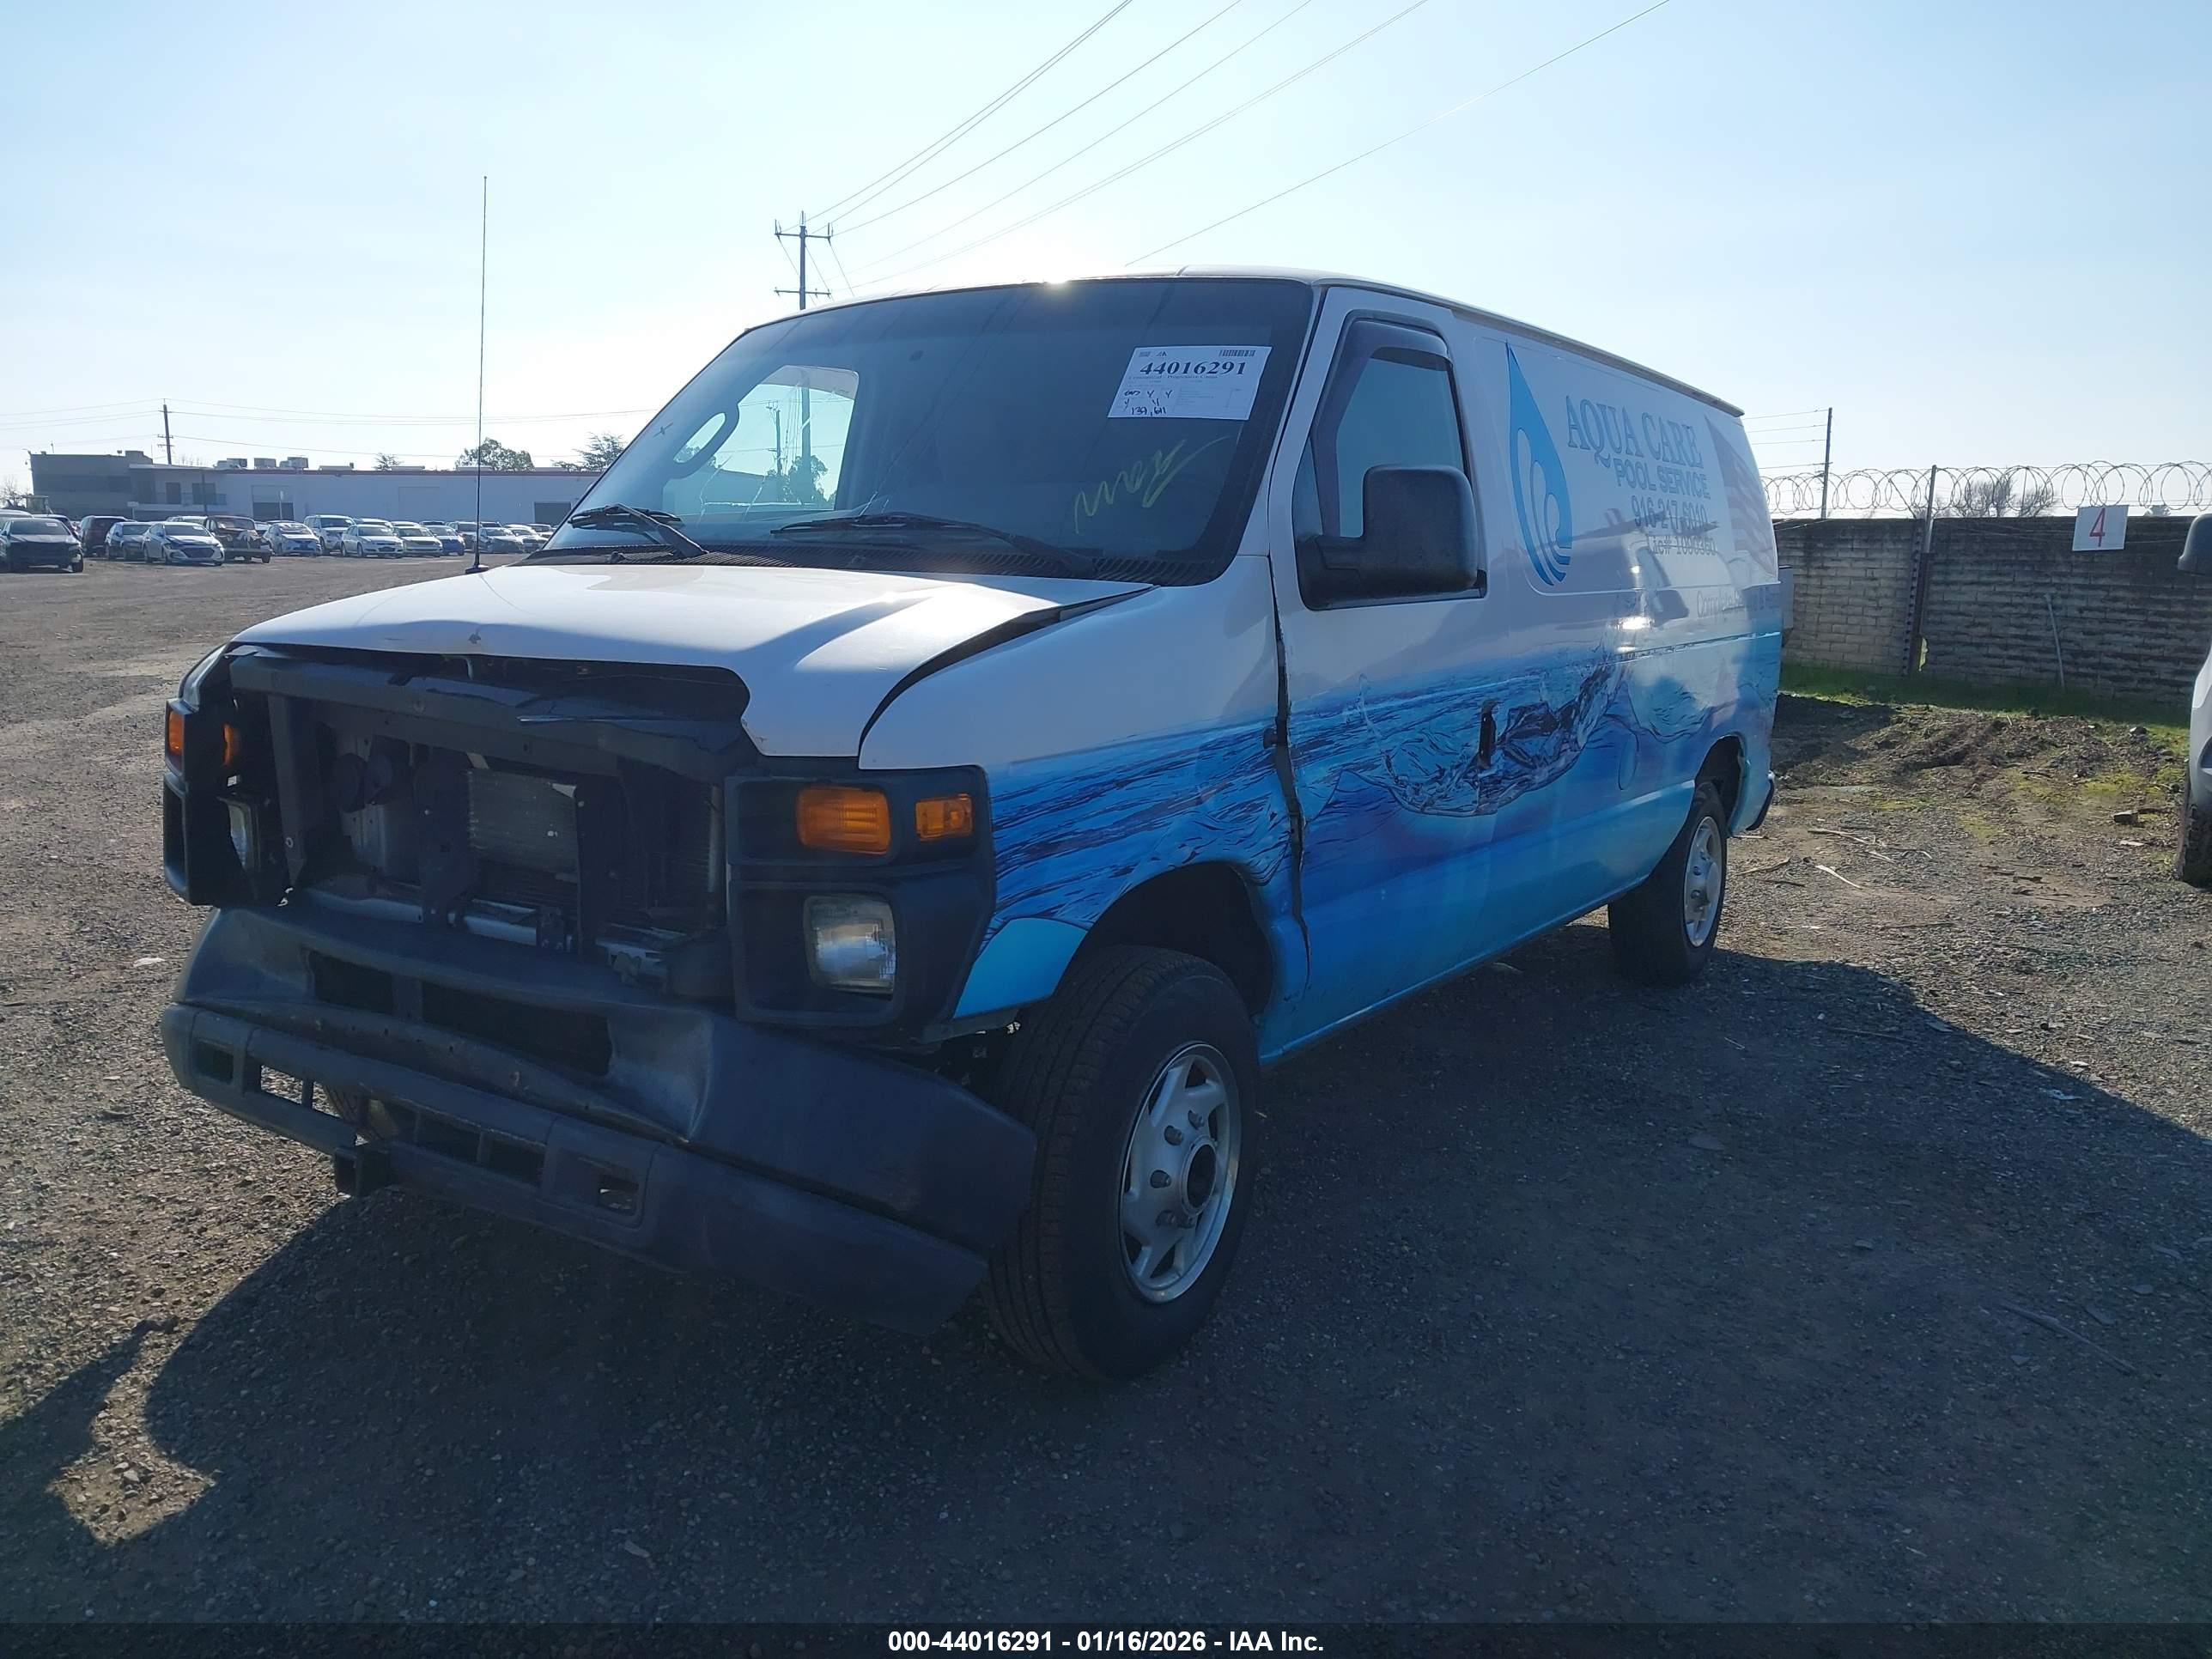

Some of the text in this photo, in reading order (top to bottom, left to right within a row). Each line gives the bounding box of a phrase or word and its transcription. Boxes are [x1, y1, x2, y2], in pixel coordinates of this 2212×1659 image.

[1139, 361, 1245, 376] 44016291
[1565, 395, 1704, 469] AQUA CARE
[1614, 459, 1711, 499] POOL SERVICE
[2088, 507, 2106, 547] 4
